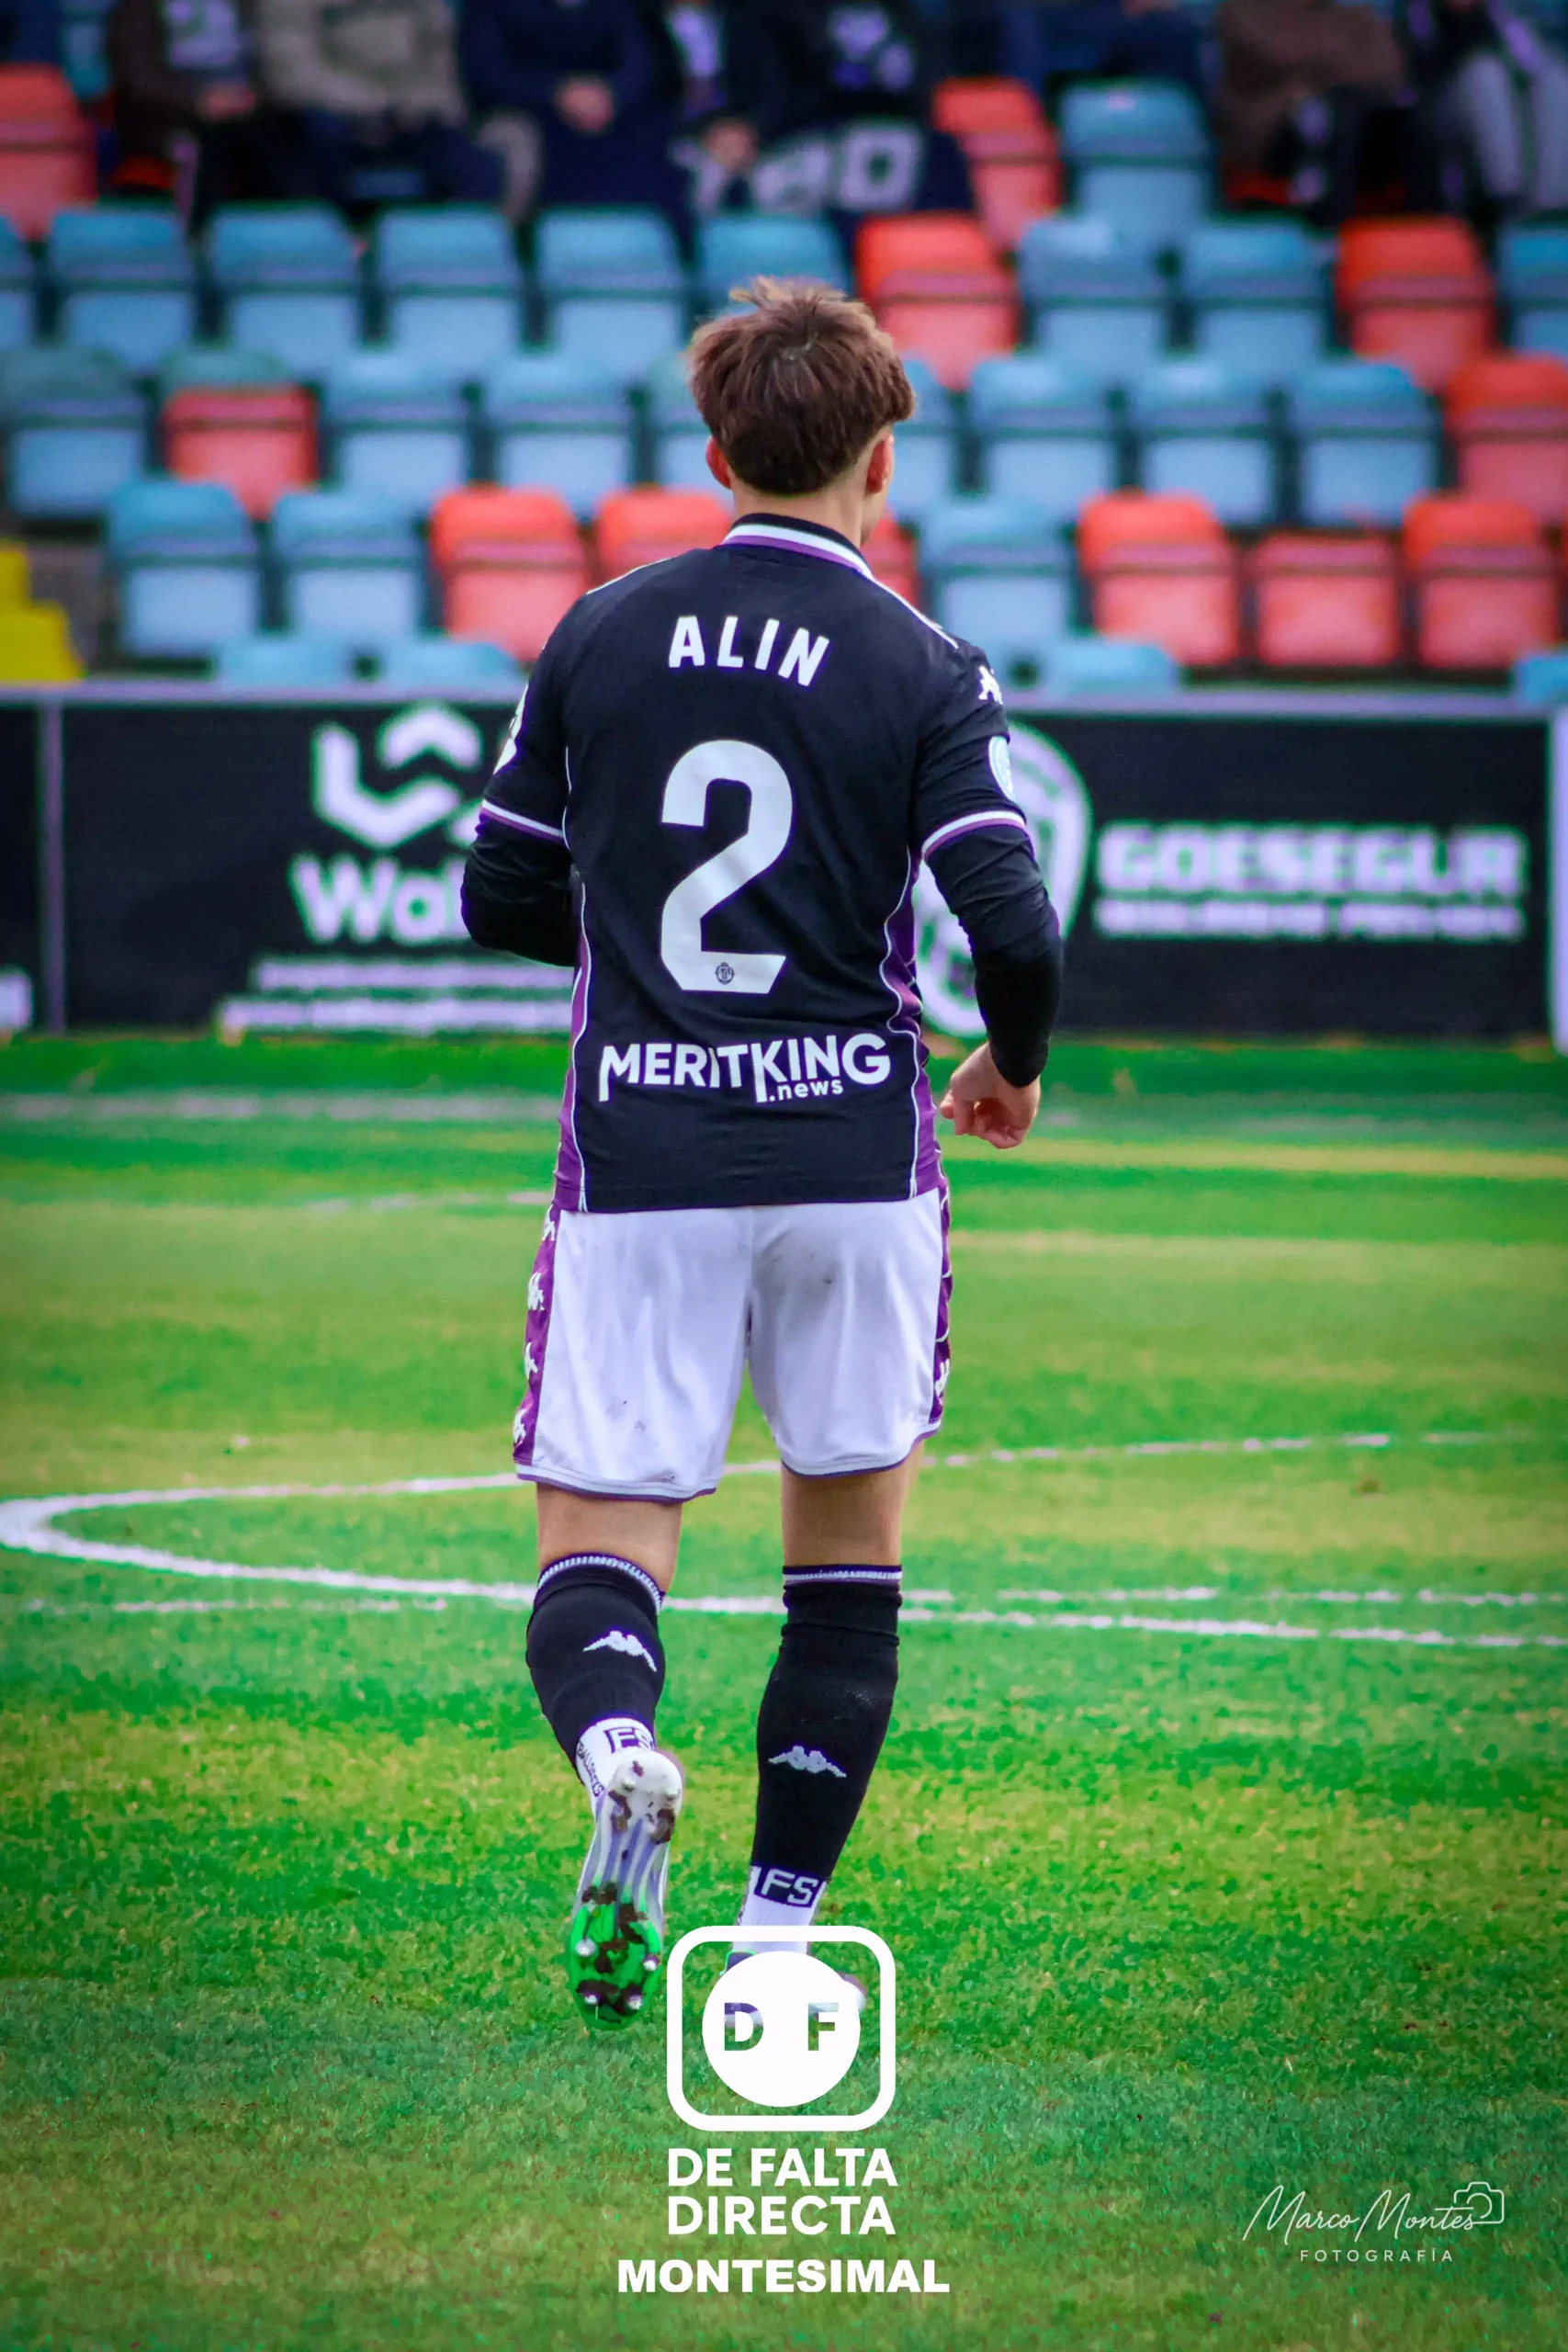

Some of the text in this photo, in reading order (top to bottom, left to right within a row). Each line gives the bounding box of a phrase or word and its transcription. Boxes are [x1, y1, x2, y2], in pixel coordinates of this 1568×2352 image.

[668, 615, 829, 687] ALIN
[660, 739, 794, 994] 2
[598, 1033, 891, 1103] MERITKING
[760, 1867, 820, 1905] FS
